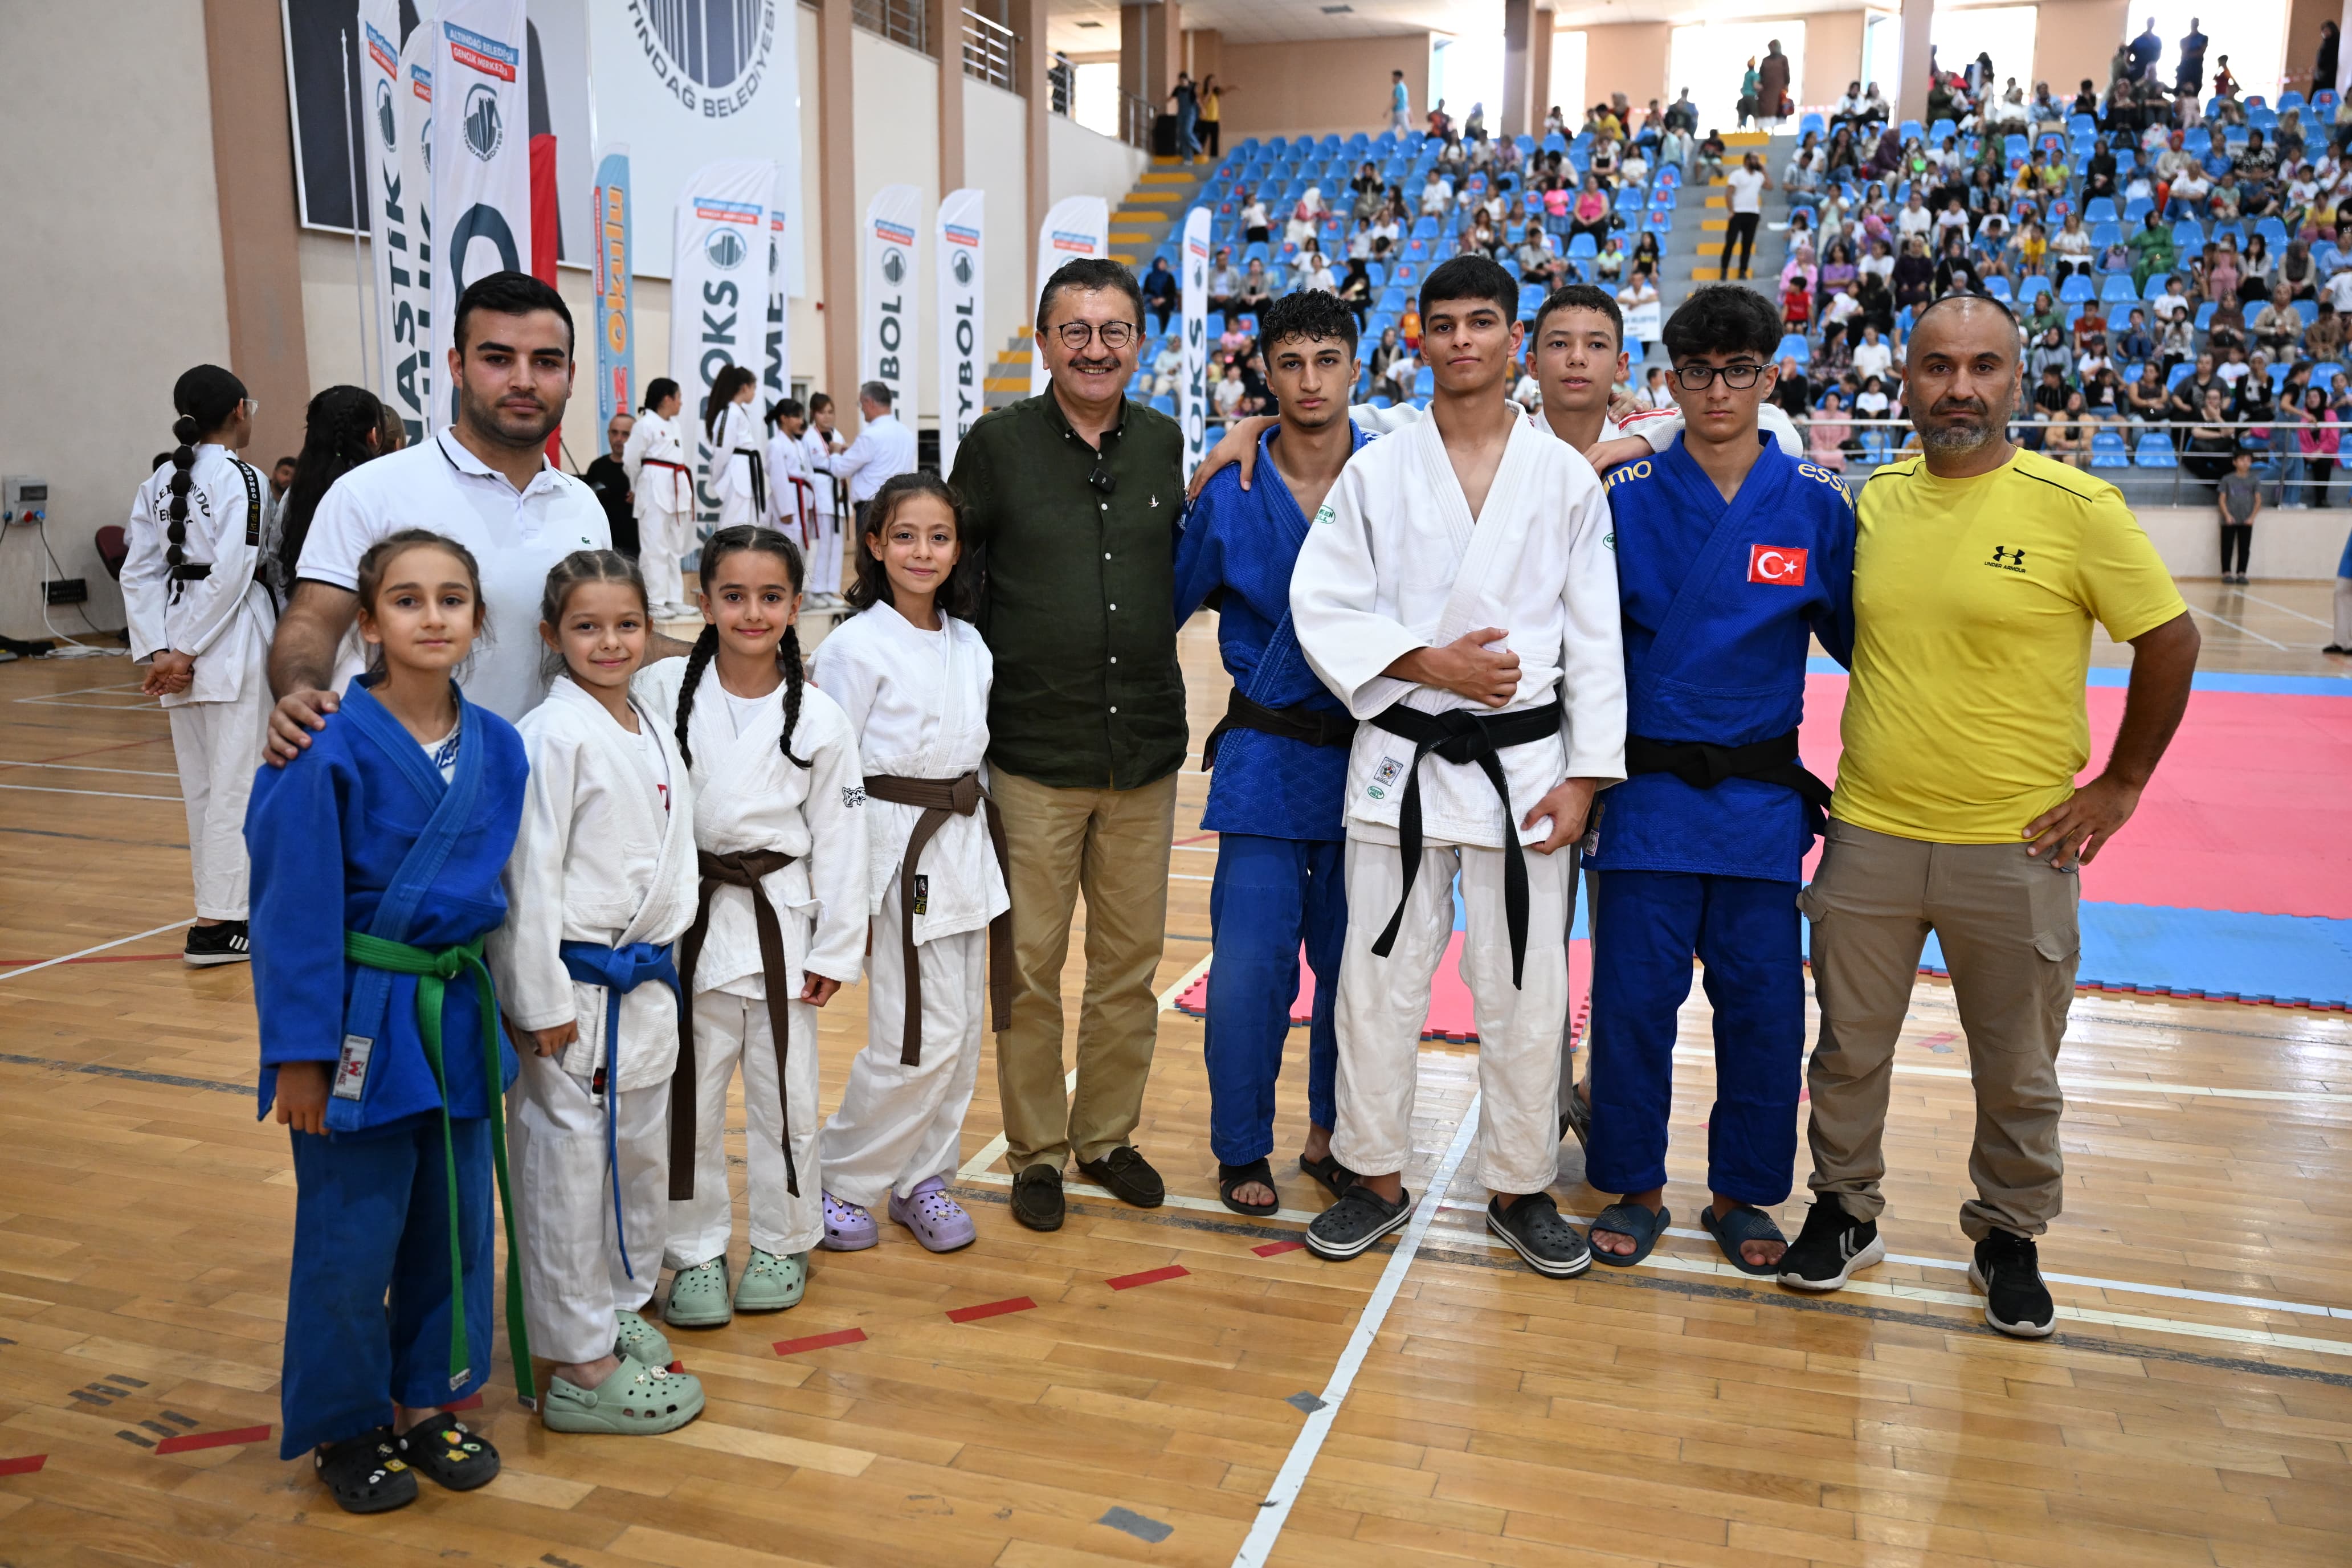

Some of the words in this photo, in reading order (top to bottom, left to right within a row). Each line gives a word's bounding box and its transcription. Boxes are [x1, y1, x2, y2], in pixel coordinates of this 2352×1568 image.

[605, 186, 626, 354] Okulu
[700, 280, 739, 419] OKS
[2003, 565, 2026, 574] ARMOUR
